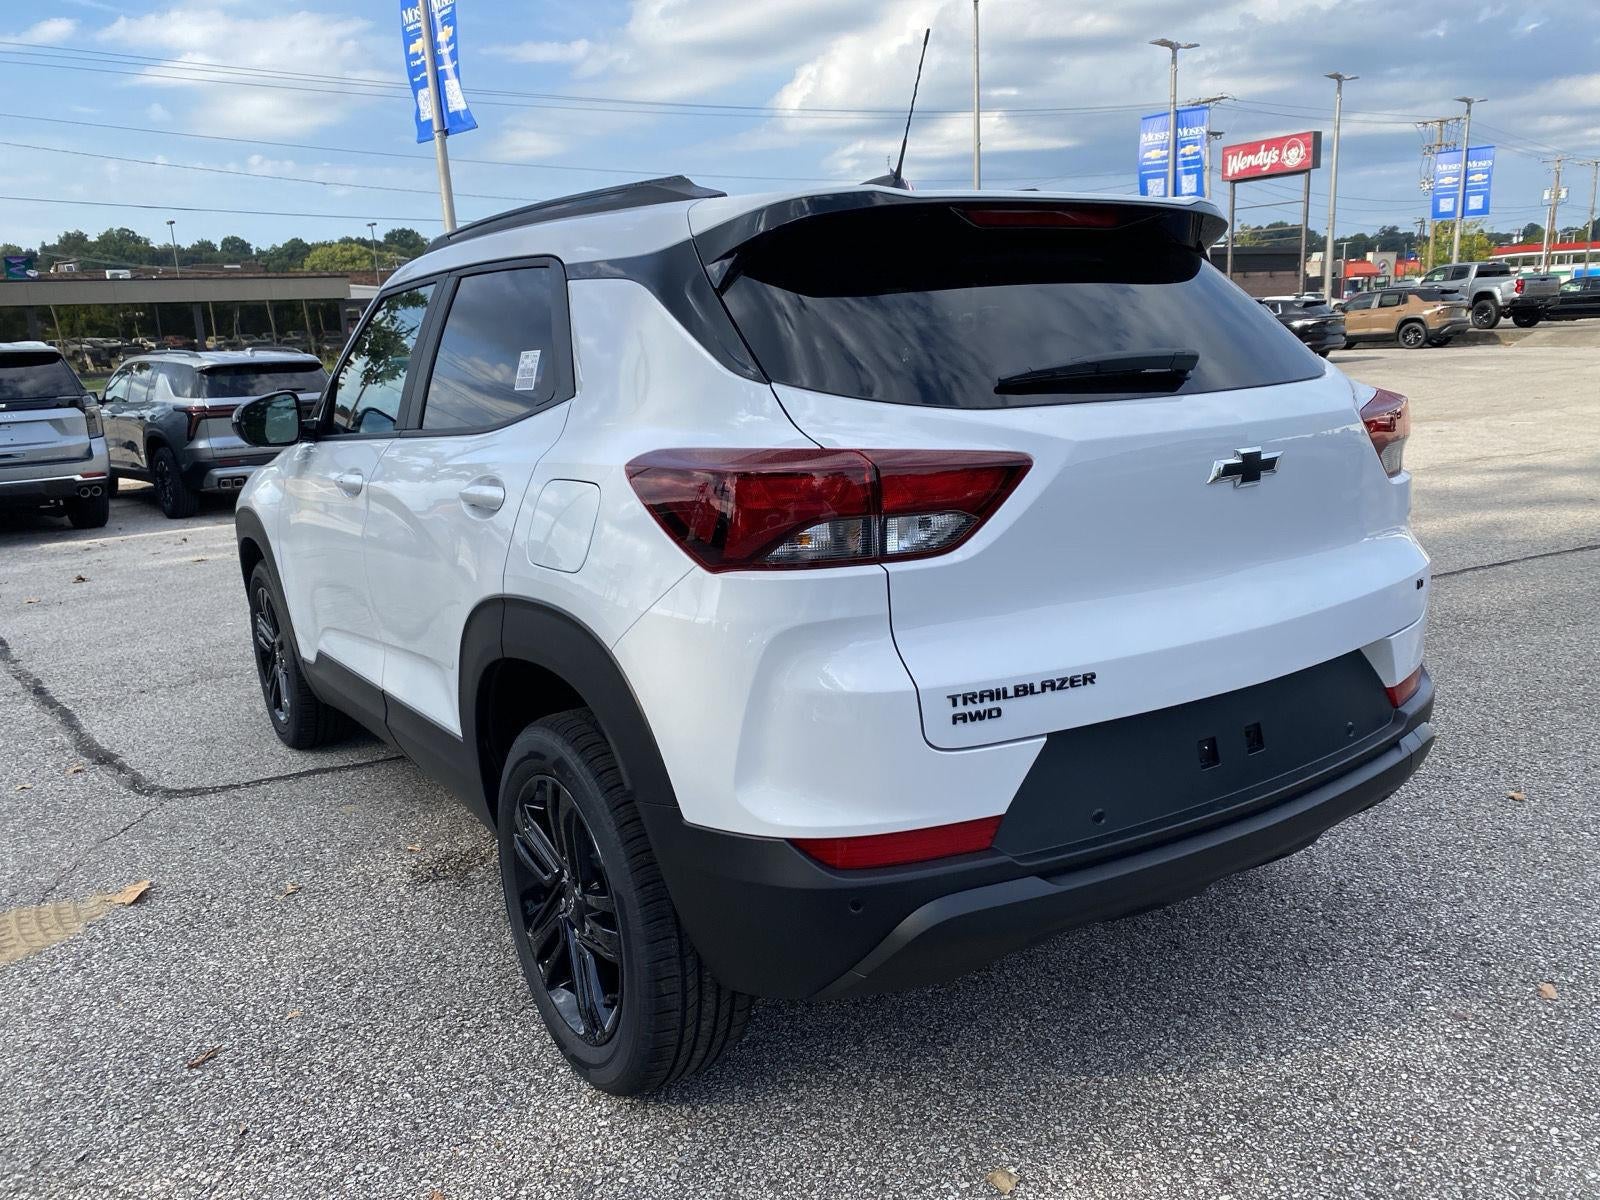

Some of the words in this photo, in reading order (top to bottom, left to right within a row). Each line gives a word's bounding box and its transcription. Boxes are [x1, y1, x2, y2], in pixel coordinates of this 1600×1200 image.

[402, 6, 421, 27] MOS
[1178, 126, 1206, 138] MOSES
[1228, 144, 1279, 177] Wendy's
[946, 671, 1097, 708] TRAILBLAZER
[951, 706, 1003, 726] AWD
